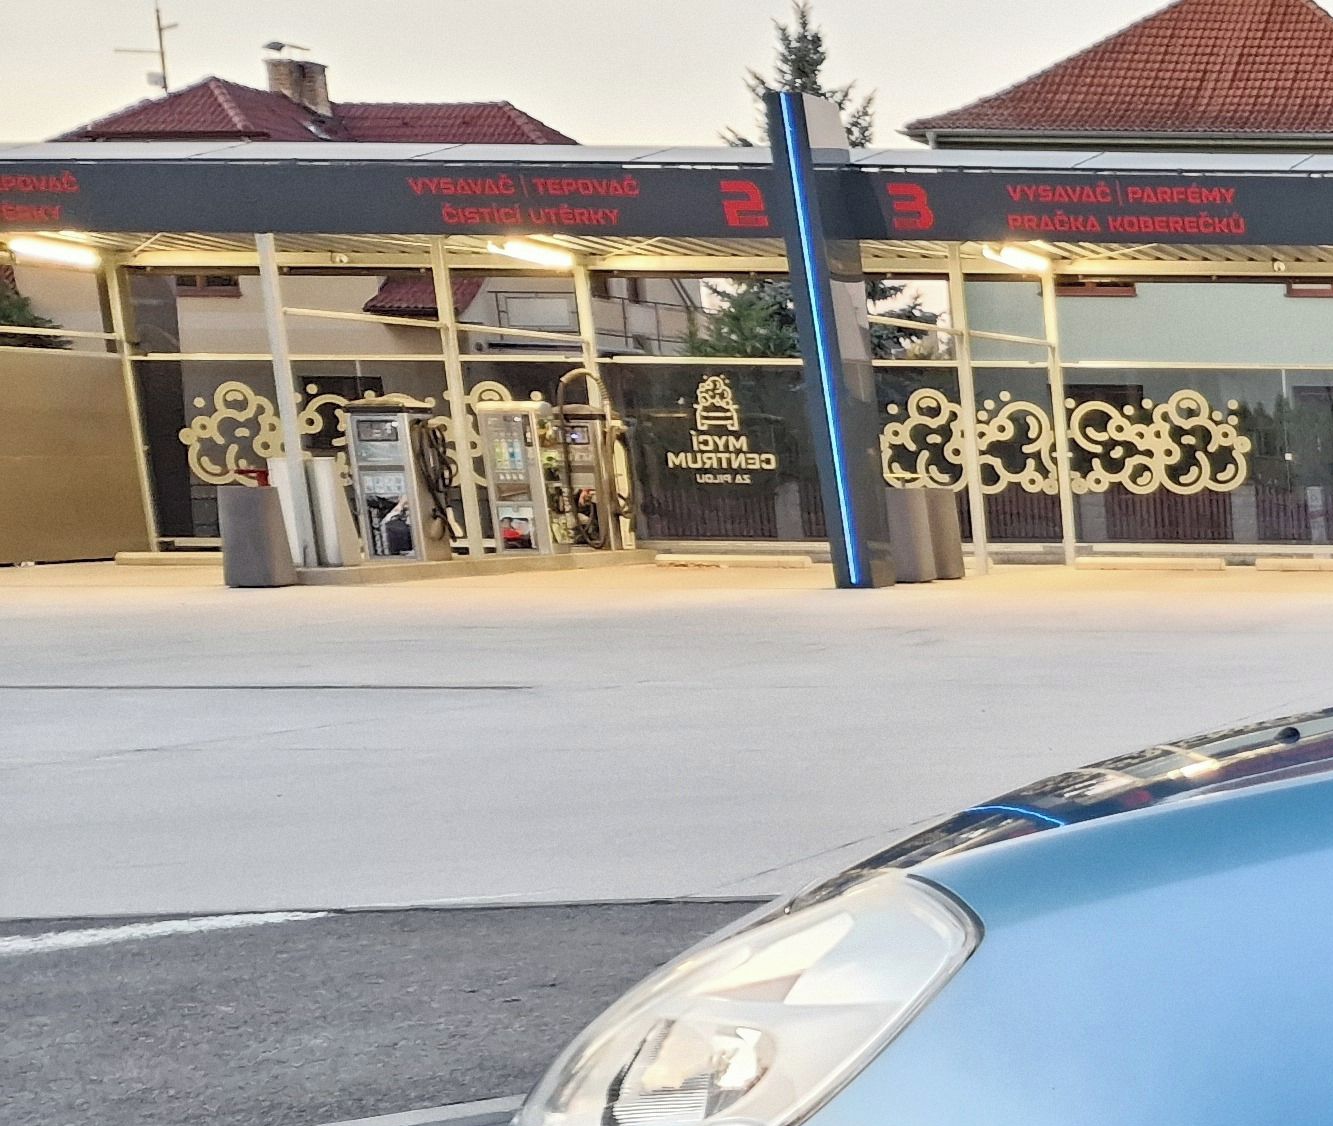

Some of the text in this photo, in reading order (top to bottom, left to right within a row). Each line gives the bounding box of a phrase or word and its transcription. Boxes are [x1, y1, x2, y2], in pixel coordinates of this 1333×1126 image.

[0, 171, 80, 192] POVAČ
[408, 174, 640, 197] VYSAVAČ TEPOVAČ
[1007, 181, 1236, 204] VYSAVAČ PARFÉMY
[441, 202, 619, 226] ČISTÍCÍ UTĚRKY
[719, 179, 769, 227] 2
[886, 182, 935, 230] 3
[1007, 209, 1246, 235] PRAČKA KOBEREČKŮ
